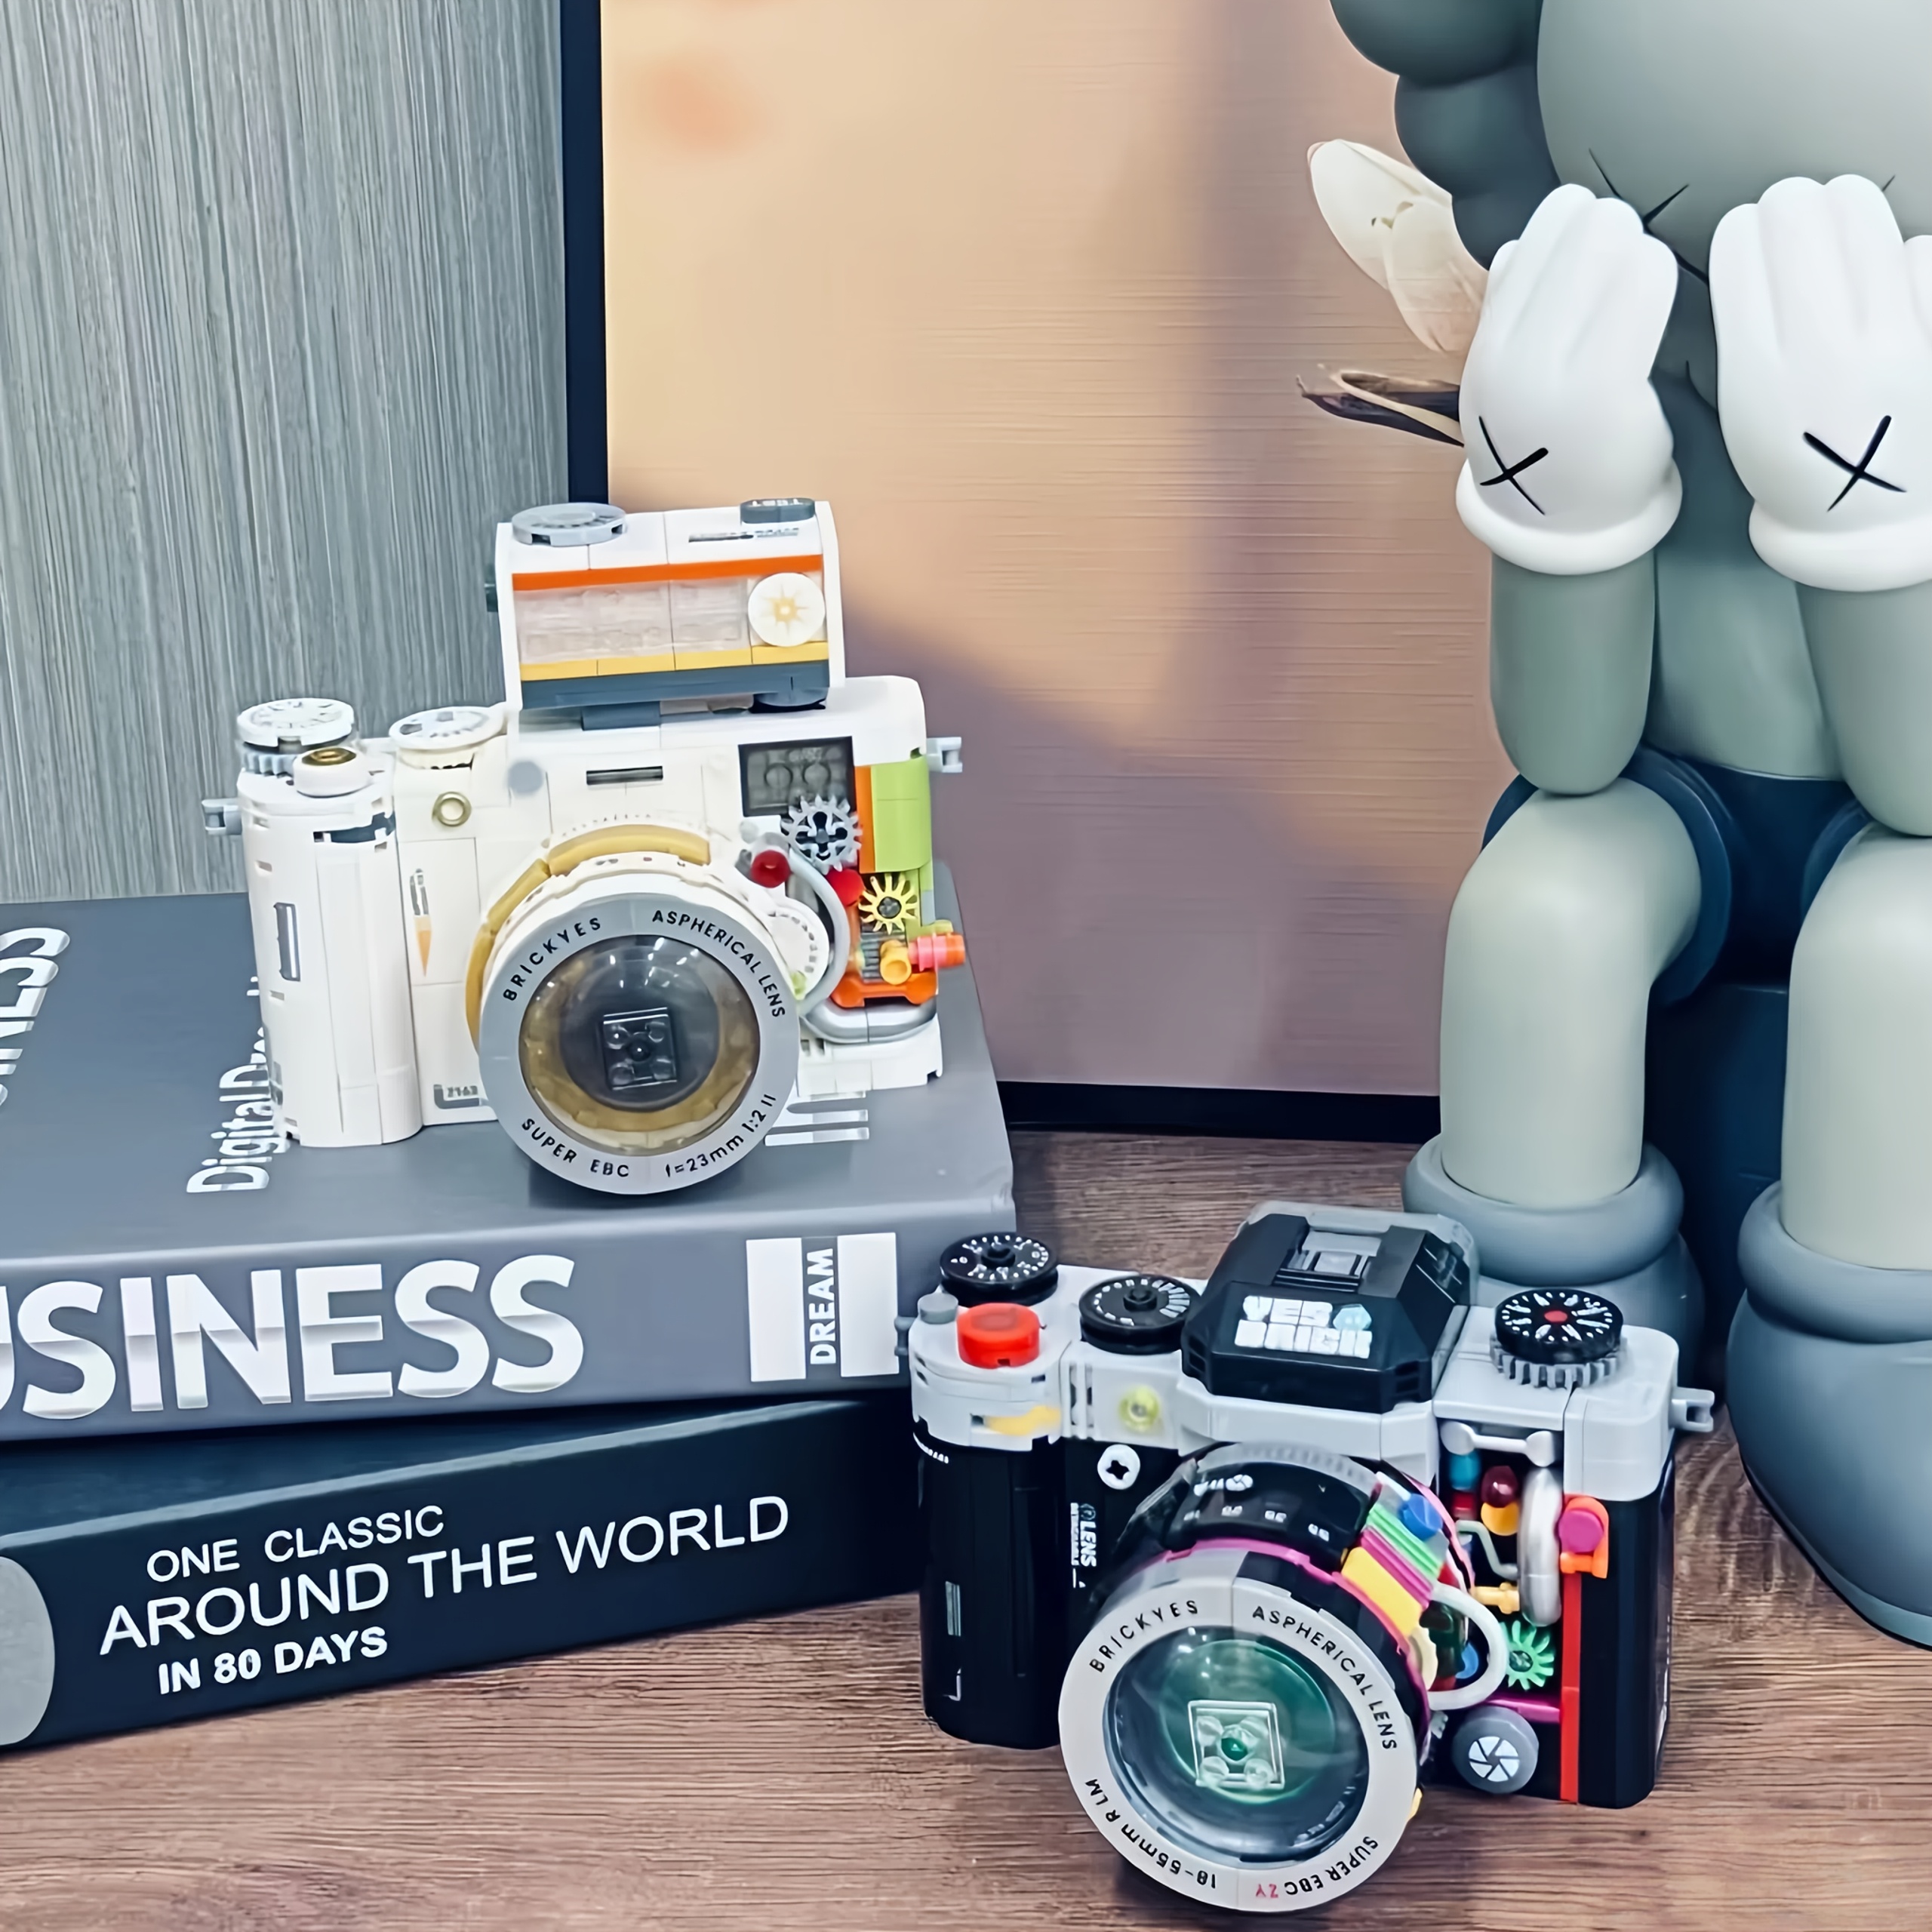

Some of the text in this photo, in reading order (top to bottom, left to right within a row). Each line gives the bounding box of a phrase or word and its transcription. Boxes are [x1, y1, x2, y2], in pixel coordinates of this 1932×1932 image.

[503, 917, 601, 1001] BRICKYES
[652, 909, 764, 974] ASPHERICAL
[758, 974, 786, 1017] LENS
[521, 1118, 629, 1177] SUPER EBC
[0, 1254, 585, 1420] SINESS
[807, 1248, 836, 1364] DREAM
[100, 1496, 788, 1655] AROUND THE WORLD
[146, 1505, 444, 1583] ONE CLASSIC
[158, 1626, 388, 1695] IN 80 DAYS
[1089, 1600, 1198, 1673] BRICKYES
[1252, 1606, 1373, 1697] ASPHERICAL
[1368, 1700, 1397, 1750] LENS
[1329, 1836, 1379, 1882] SUPER
